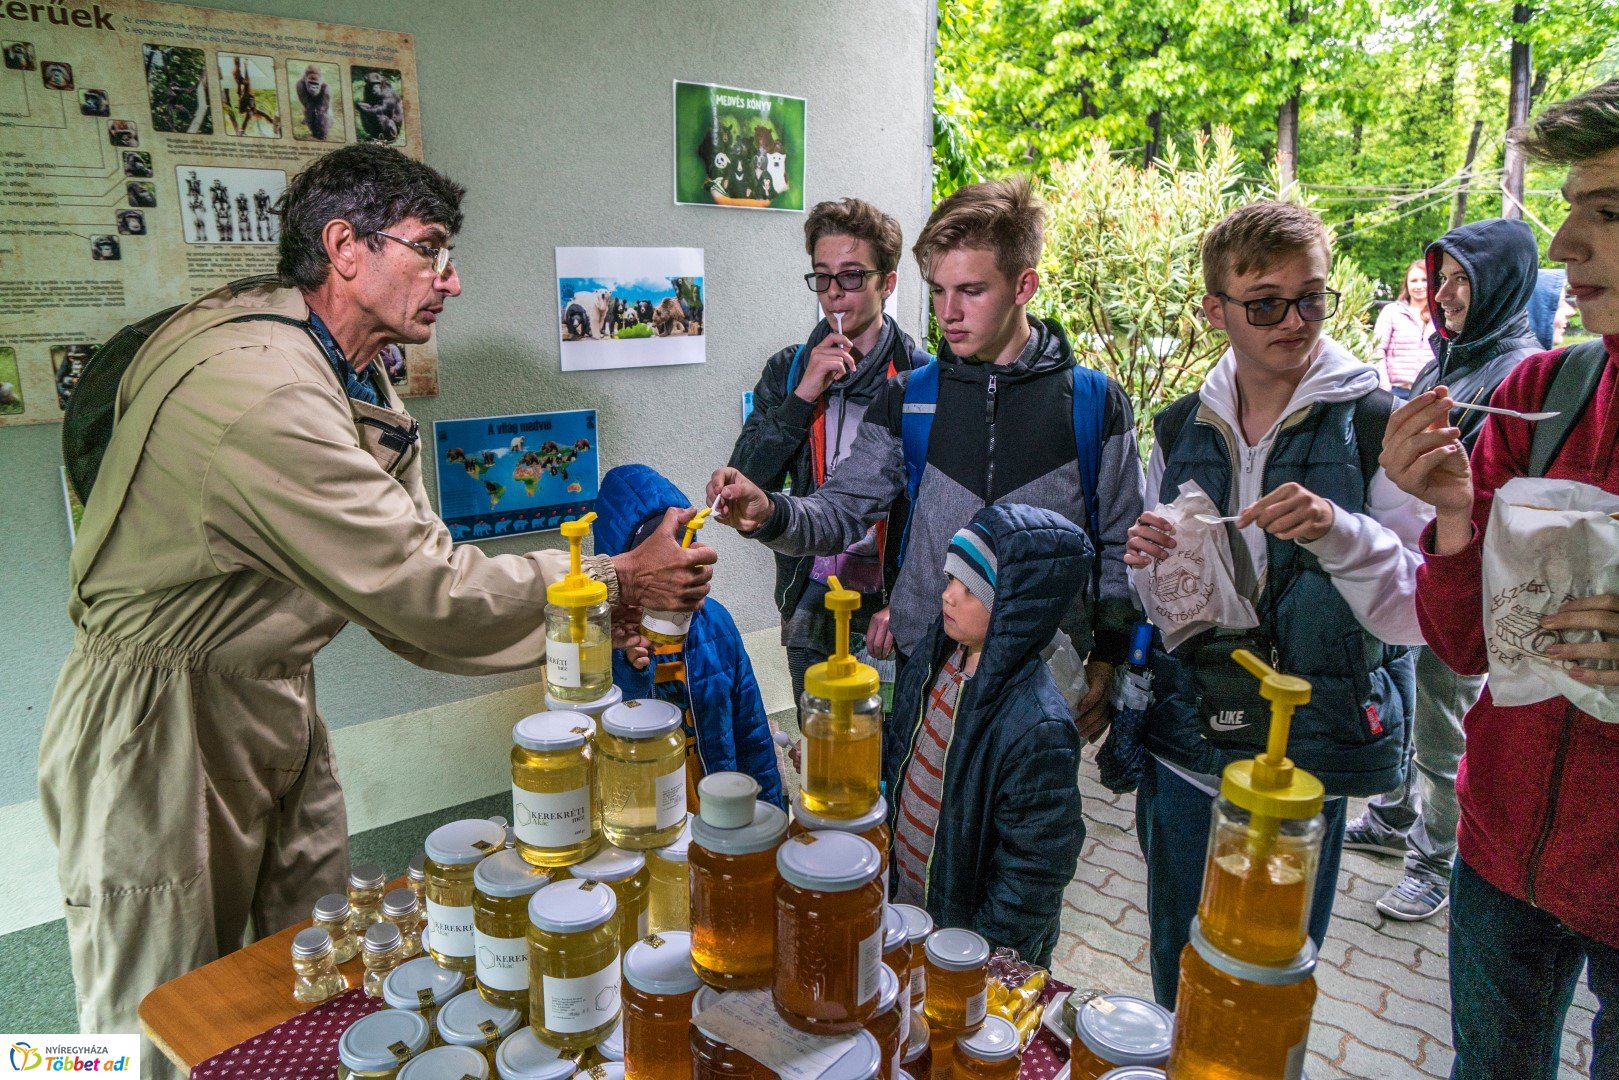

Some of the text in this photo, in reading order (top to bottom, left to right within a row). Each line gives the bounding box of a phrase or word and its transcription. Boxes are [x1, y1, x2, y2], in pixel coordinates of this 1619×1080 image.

[716, 94, 745, 108] MEDVÉS
[487, 419, 552, 435] A világ medvéi
[531, 806, 585, 820] KEREKRÉTI
[496, 954, 528, 964] KEREK
